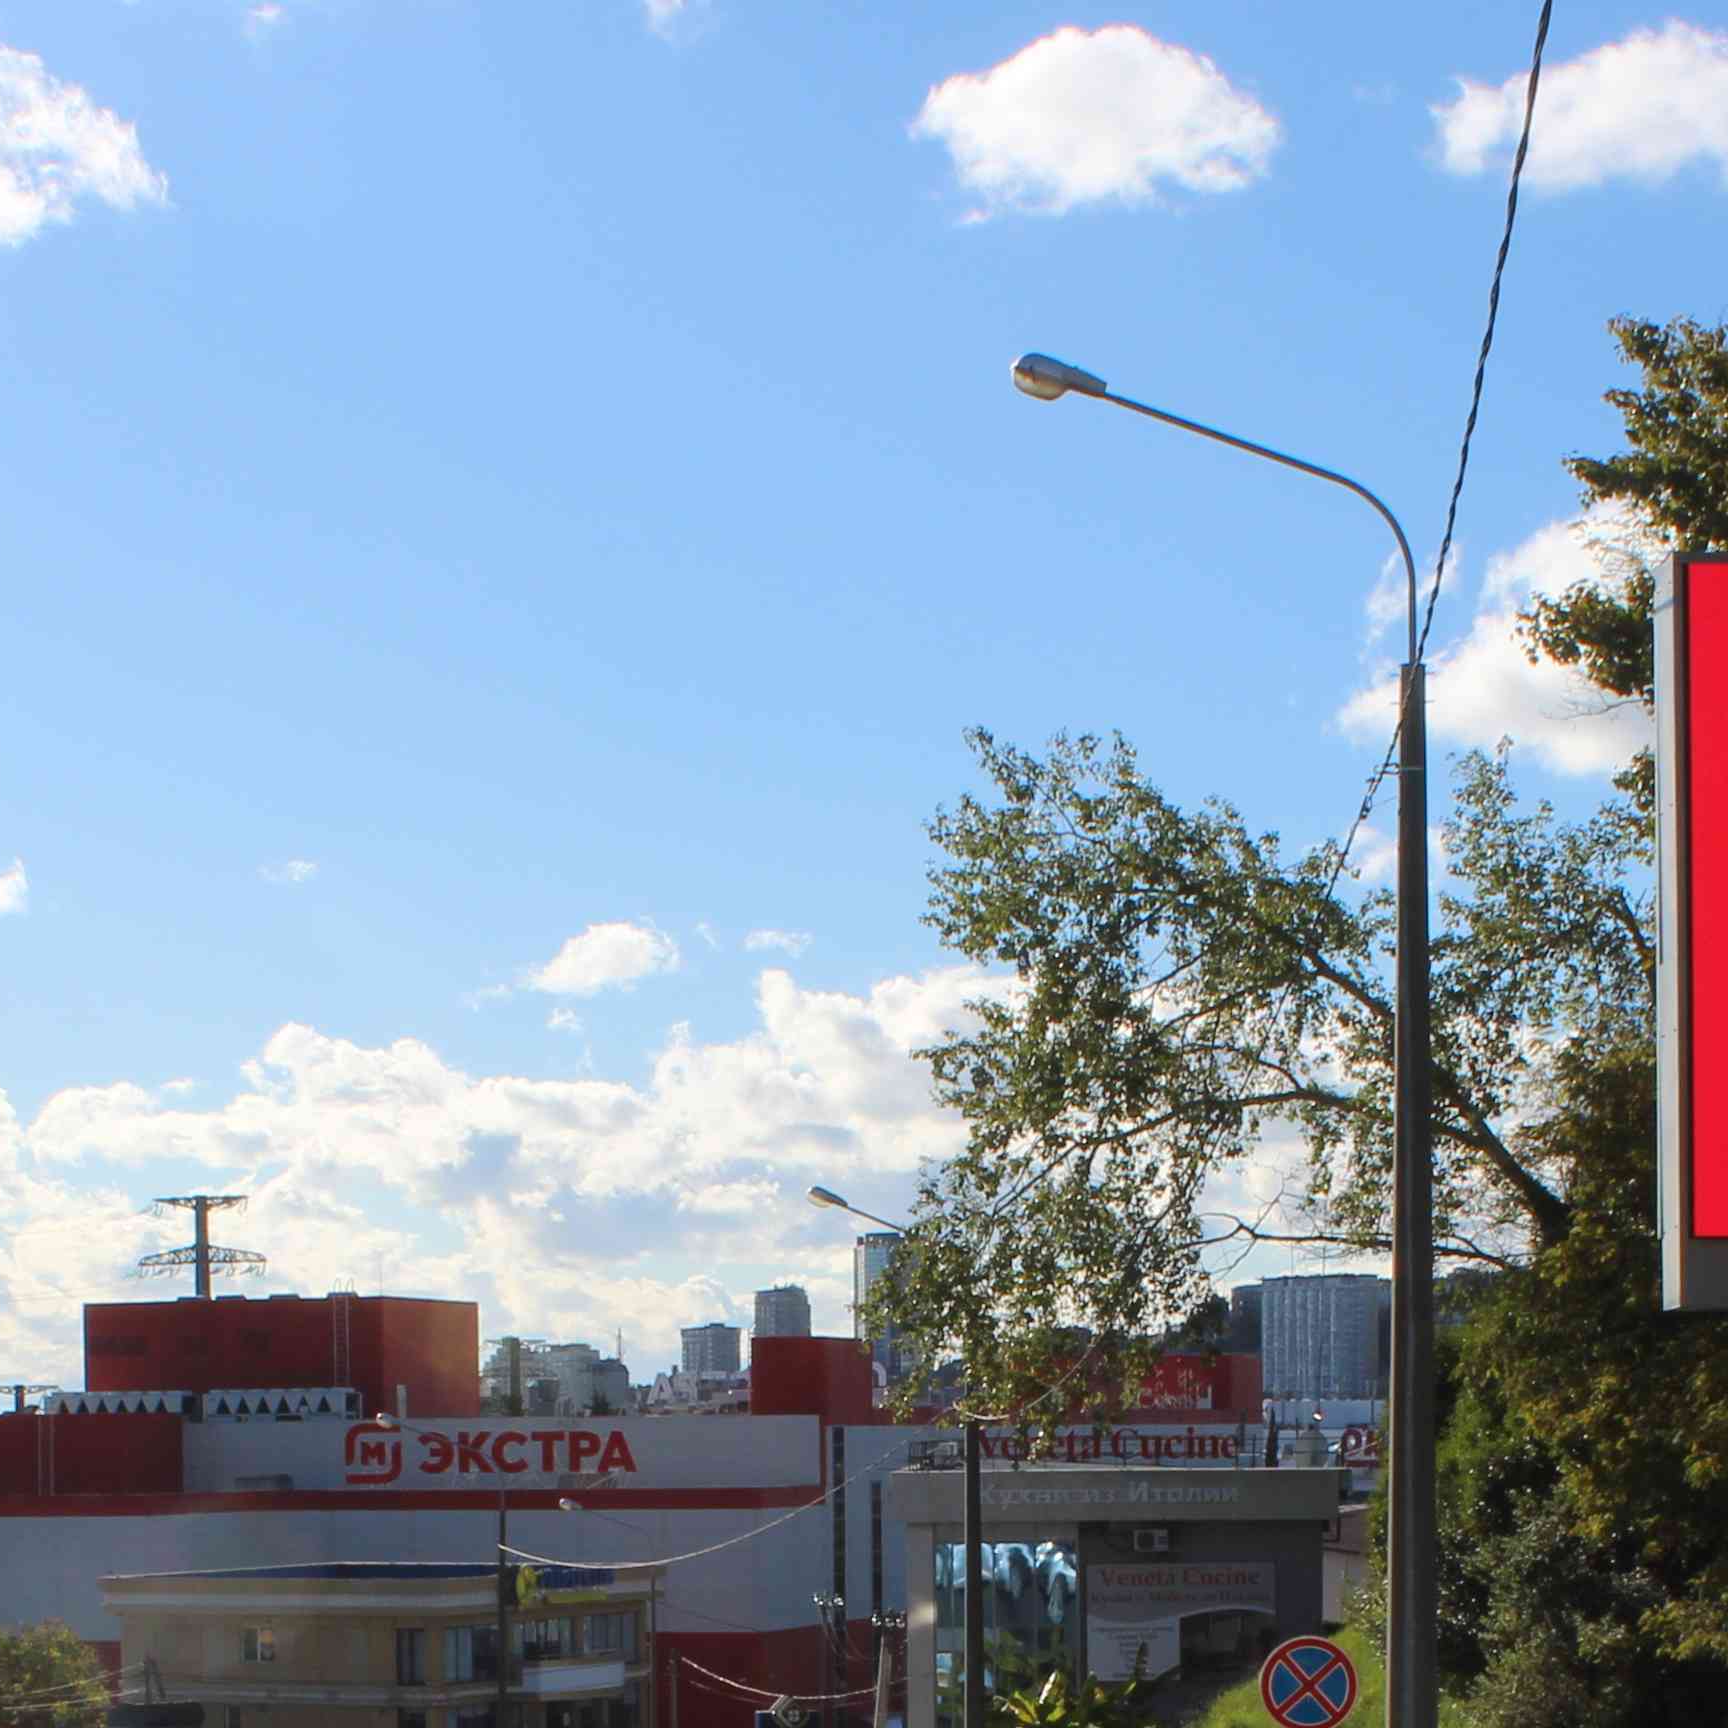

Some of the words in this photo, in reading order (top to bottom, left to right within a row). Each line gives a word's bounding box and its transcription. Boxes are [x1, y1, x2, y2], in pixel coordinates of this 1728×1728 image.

[417, 1430, 637, 1473] ЭКСТРА
[976, 1428, 1101, 1460] Veeta
[1112, 1426, 1241, 1460] Cucine
